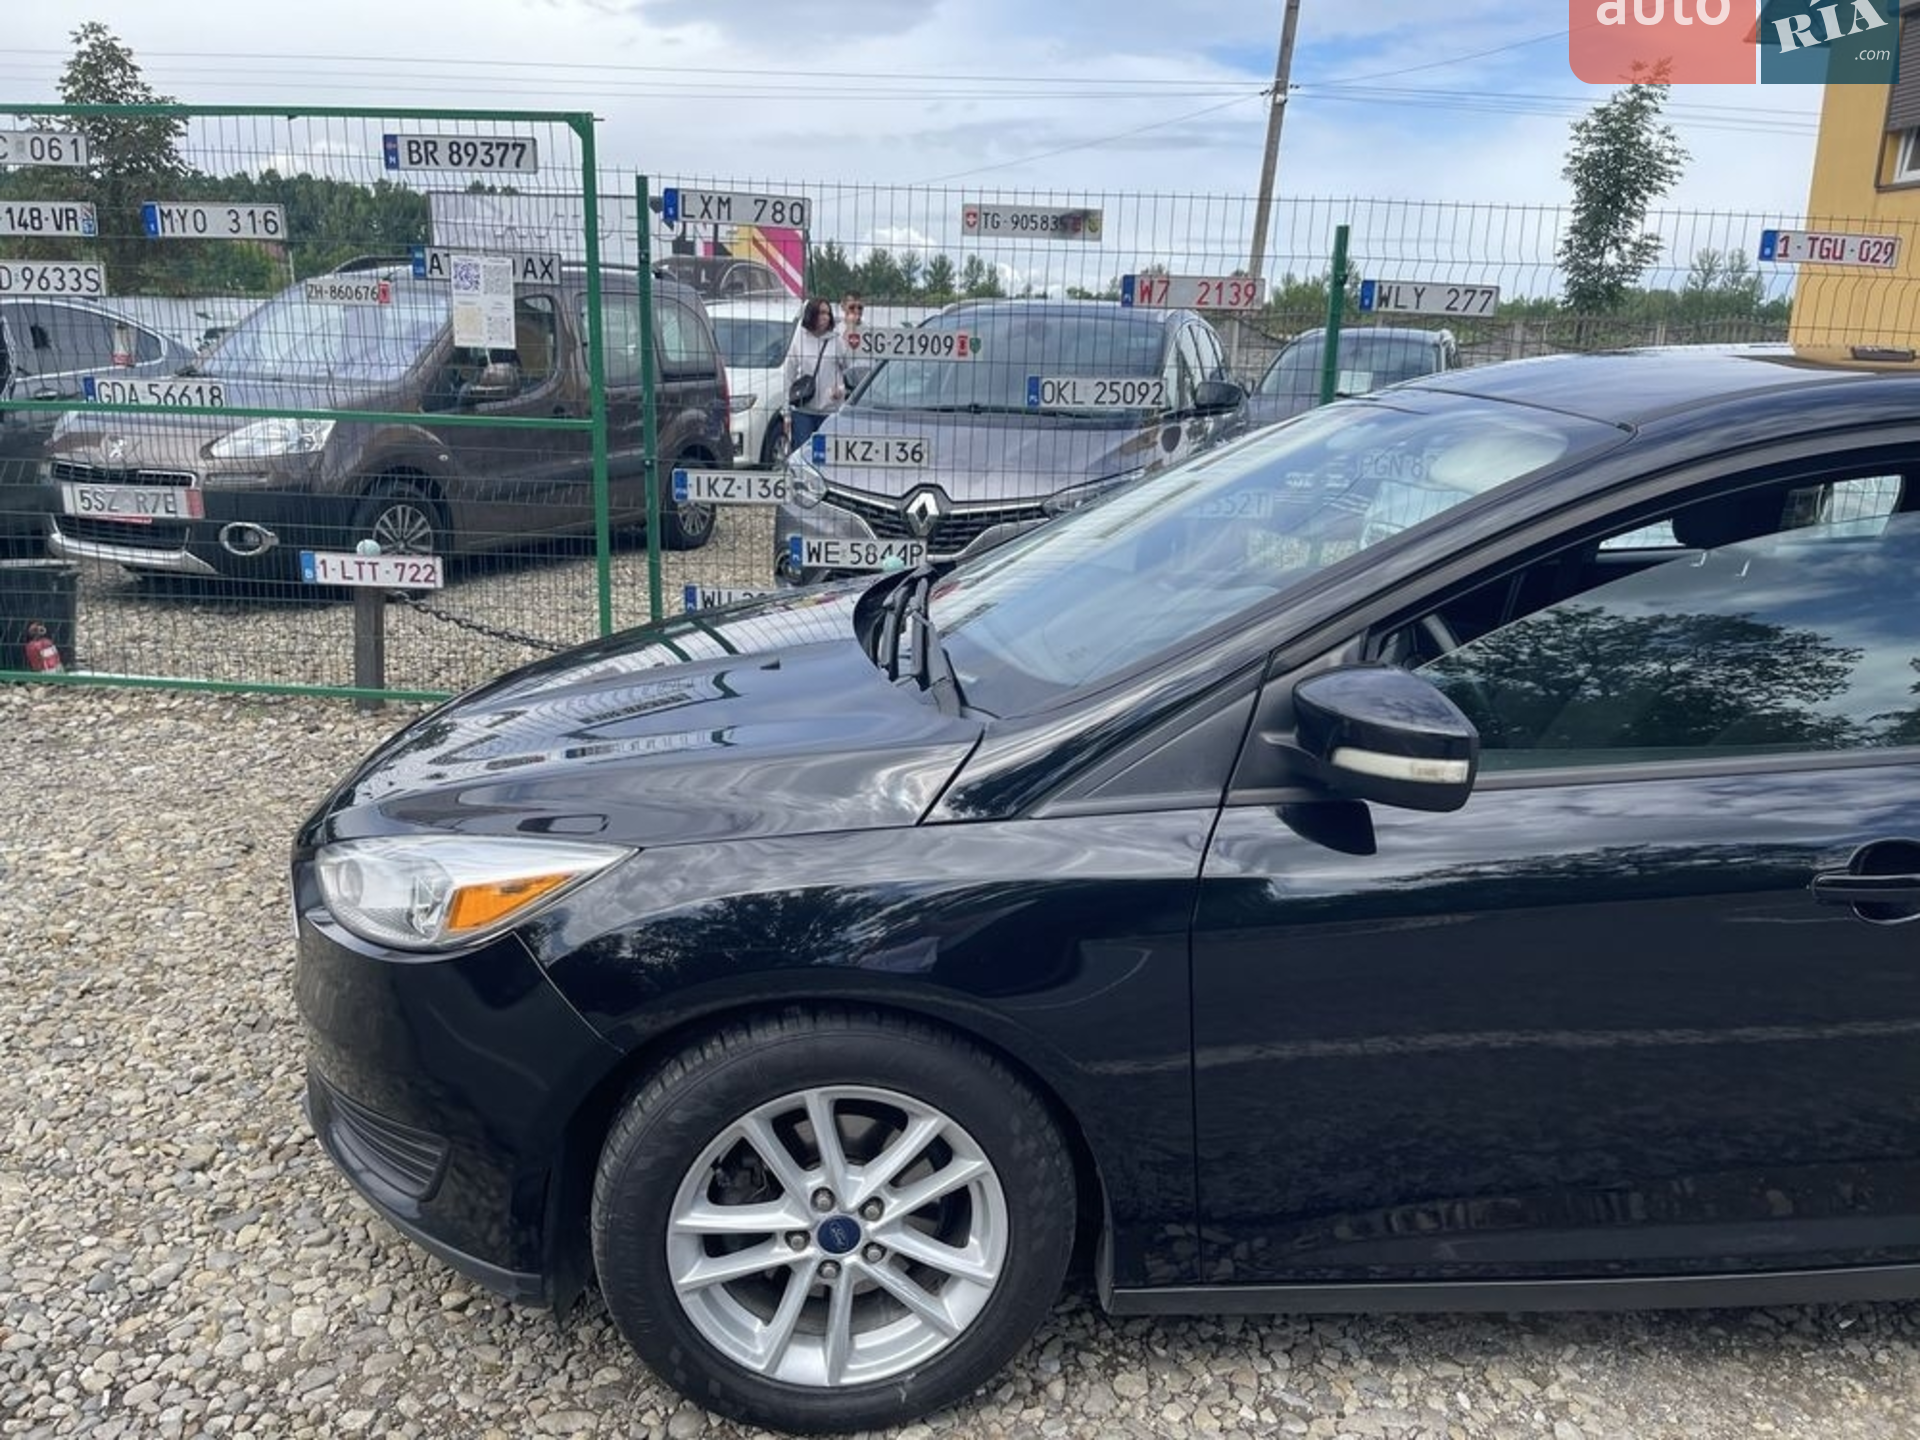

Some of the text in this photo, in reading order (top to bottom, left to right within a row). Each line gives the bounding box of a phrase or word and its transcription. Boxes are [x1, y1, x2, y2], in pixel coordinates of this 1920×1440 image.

[30, 136, 80, 162] 061
[408, 140, 526, 168] BR 89377
[160, 208, 279, 235] MYO 316
[681, 194, 804, 226] LXM 780
[21, 265, 101, 292] 9633S
[523, 257, 555, 281] AX
[1139, 279, 1257, 306] W7 2139
[1378, 284, 1494, 313] WLY 277
[97, 381, 225, 408] GDA 56618
[1041, 381, 1164, 406] OKL 25092
[807, 542, 840, 563] WE
